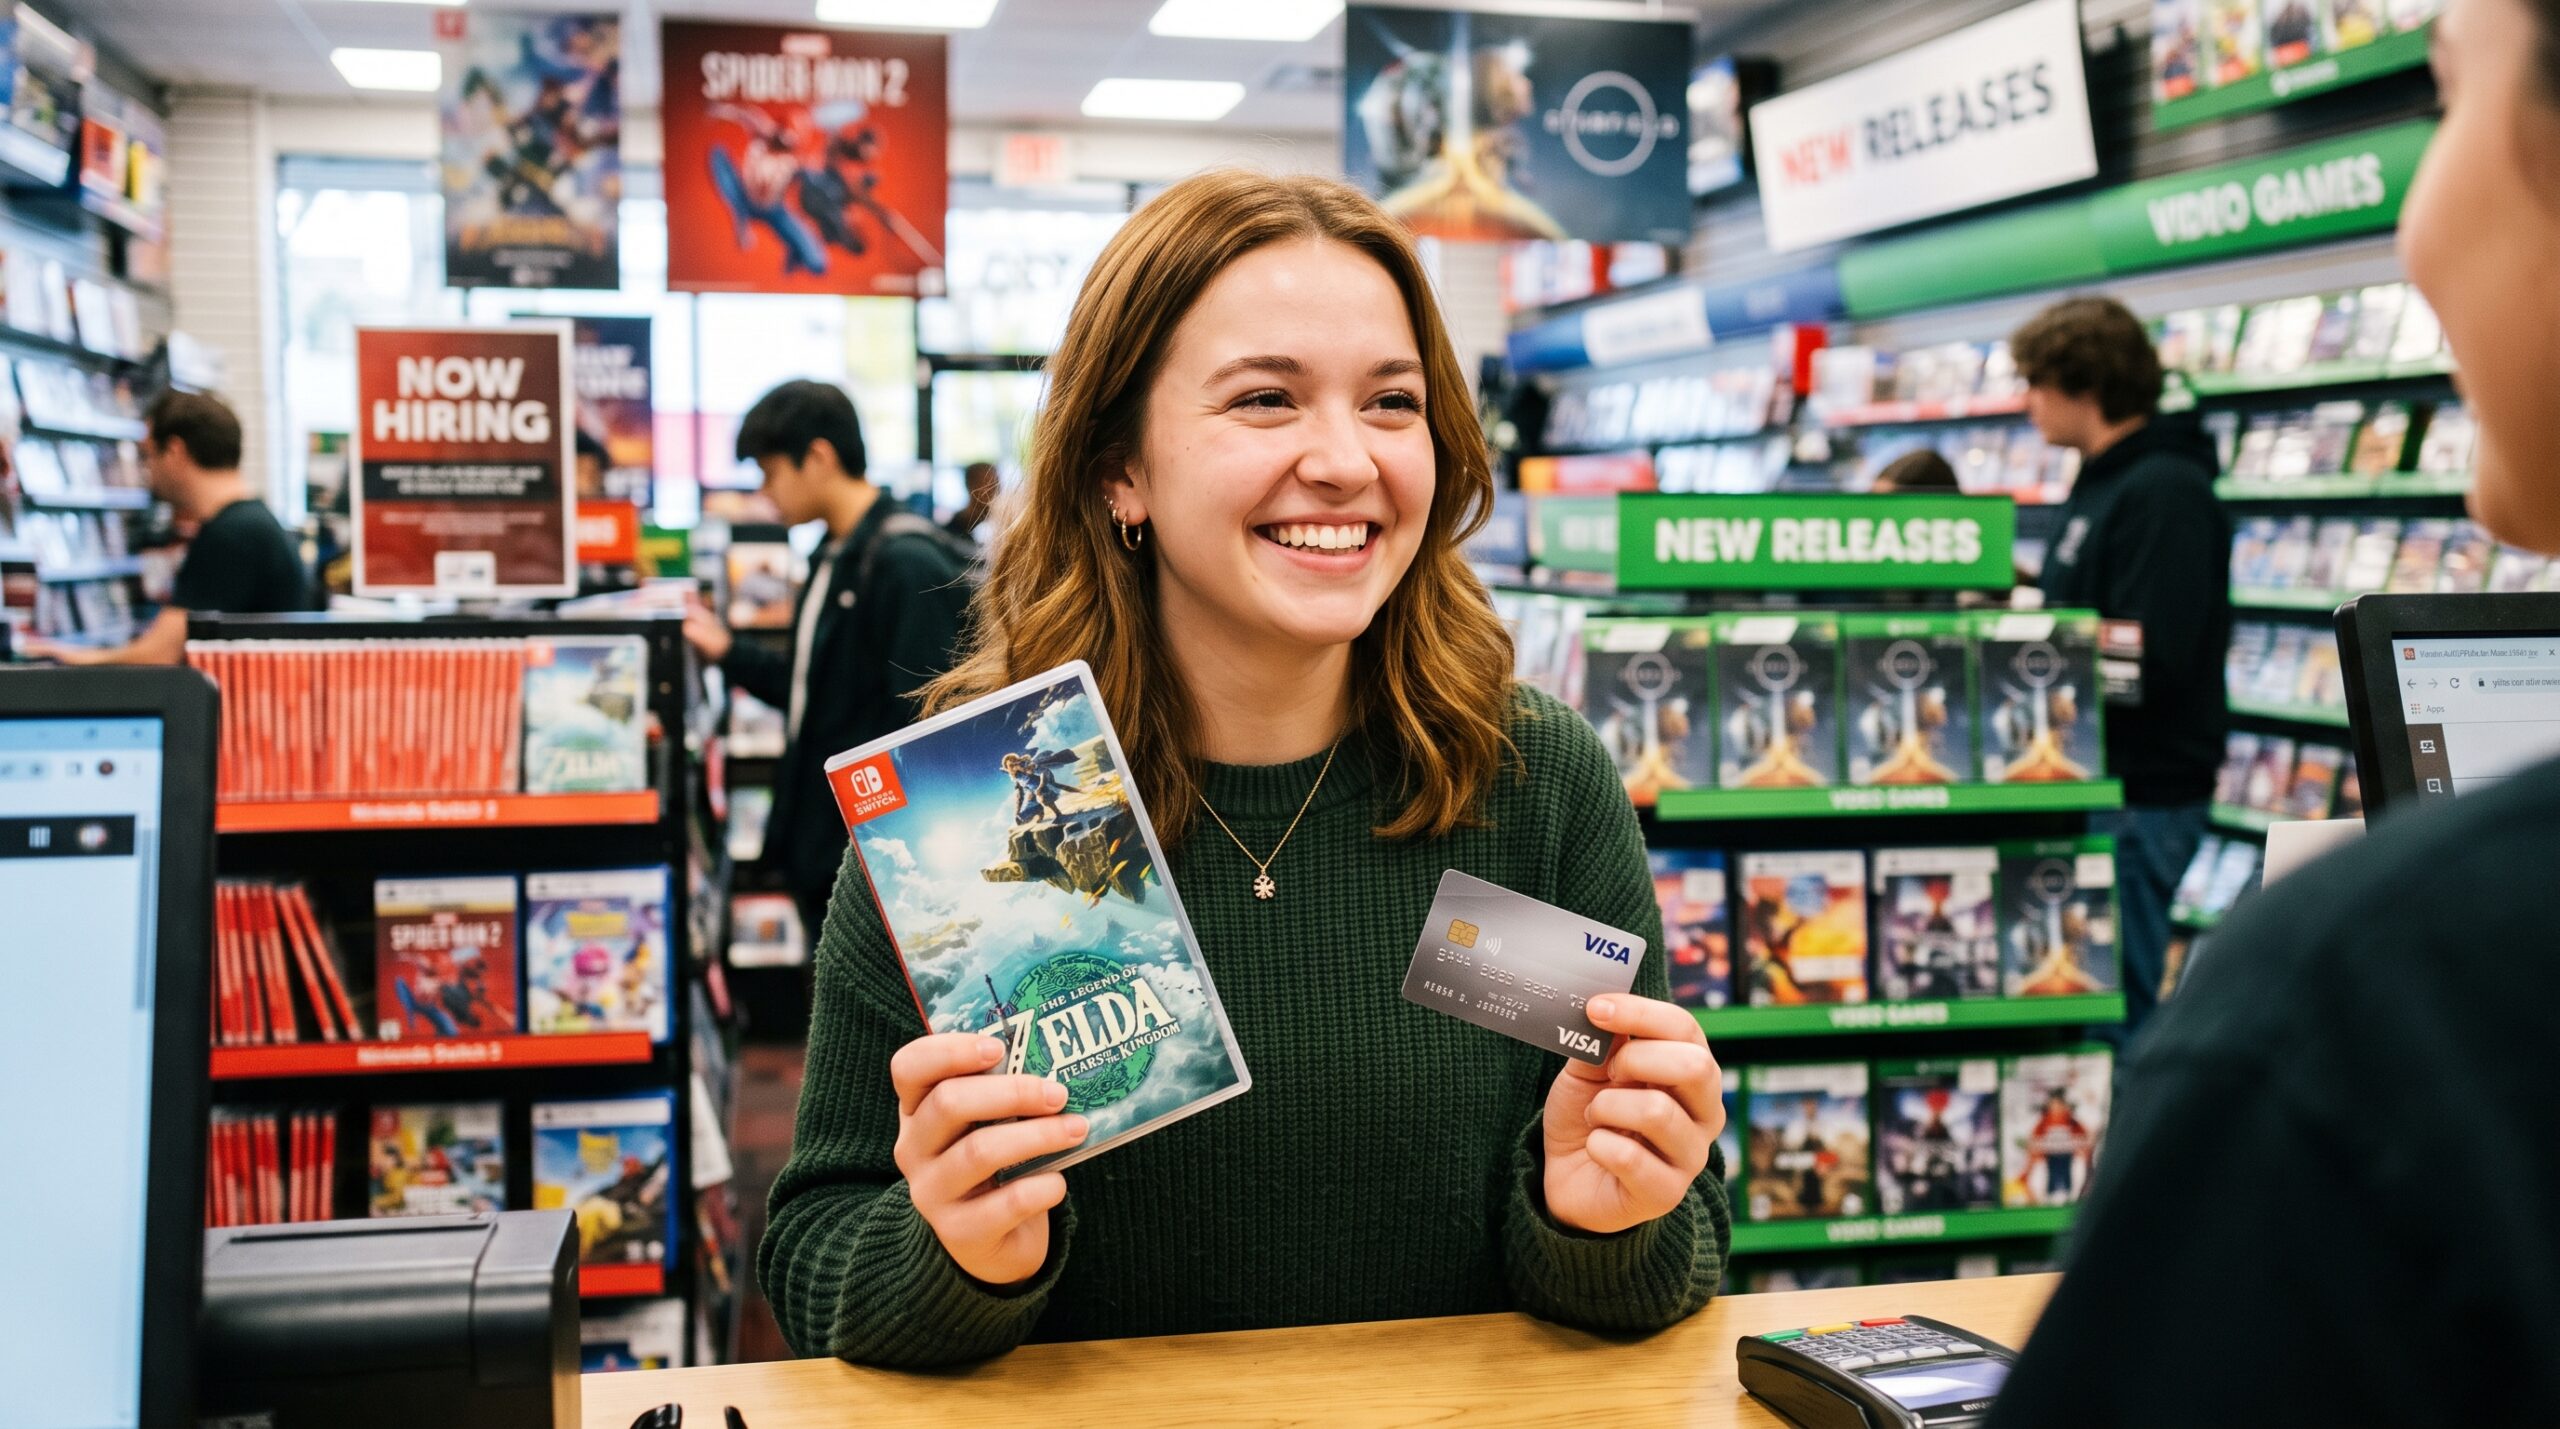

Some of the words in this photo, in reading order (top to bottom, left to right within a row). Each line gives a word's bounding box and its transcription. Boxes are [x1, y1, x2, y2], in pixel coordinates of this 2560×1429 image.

[1780, 127, 1852, 184] NEW
[1863, 62, 2053, 162] RELEASES
[2148, 181, 2249, 245] VIDEO
[2252, 152, 2385, 226] GAMES
[397, 356, 524, 399] NOW
[373, 400, 551, 443] HIRING
[1655, 517, 1762, 563] NEW
[1771, 518, 1981, 564] RELEASES
[856, 794, 897, 816] SWITCH
[1584, 932, 1630, 965] VISA
[1039, 995, 1066, 1012] THE
[1070, 973, 1120, 1001] LEGEND
[1122, 966, 1138, 978] OF
[978, 978, 1176, 1081] ZELDA
[1059, 1055, 1104, 1083] TEARS
[1120, 1022, 1181, 1060] KINGDOM
[1557, 1025, 1601, 1056] VISA
